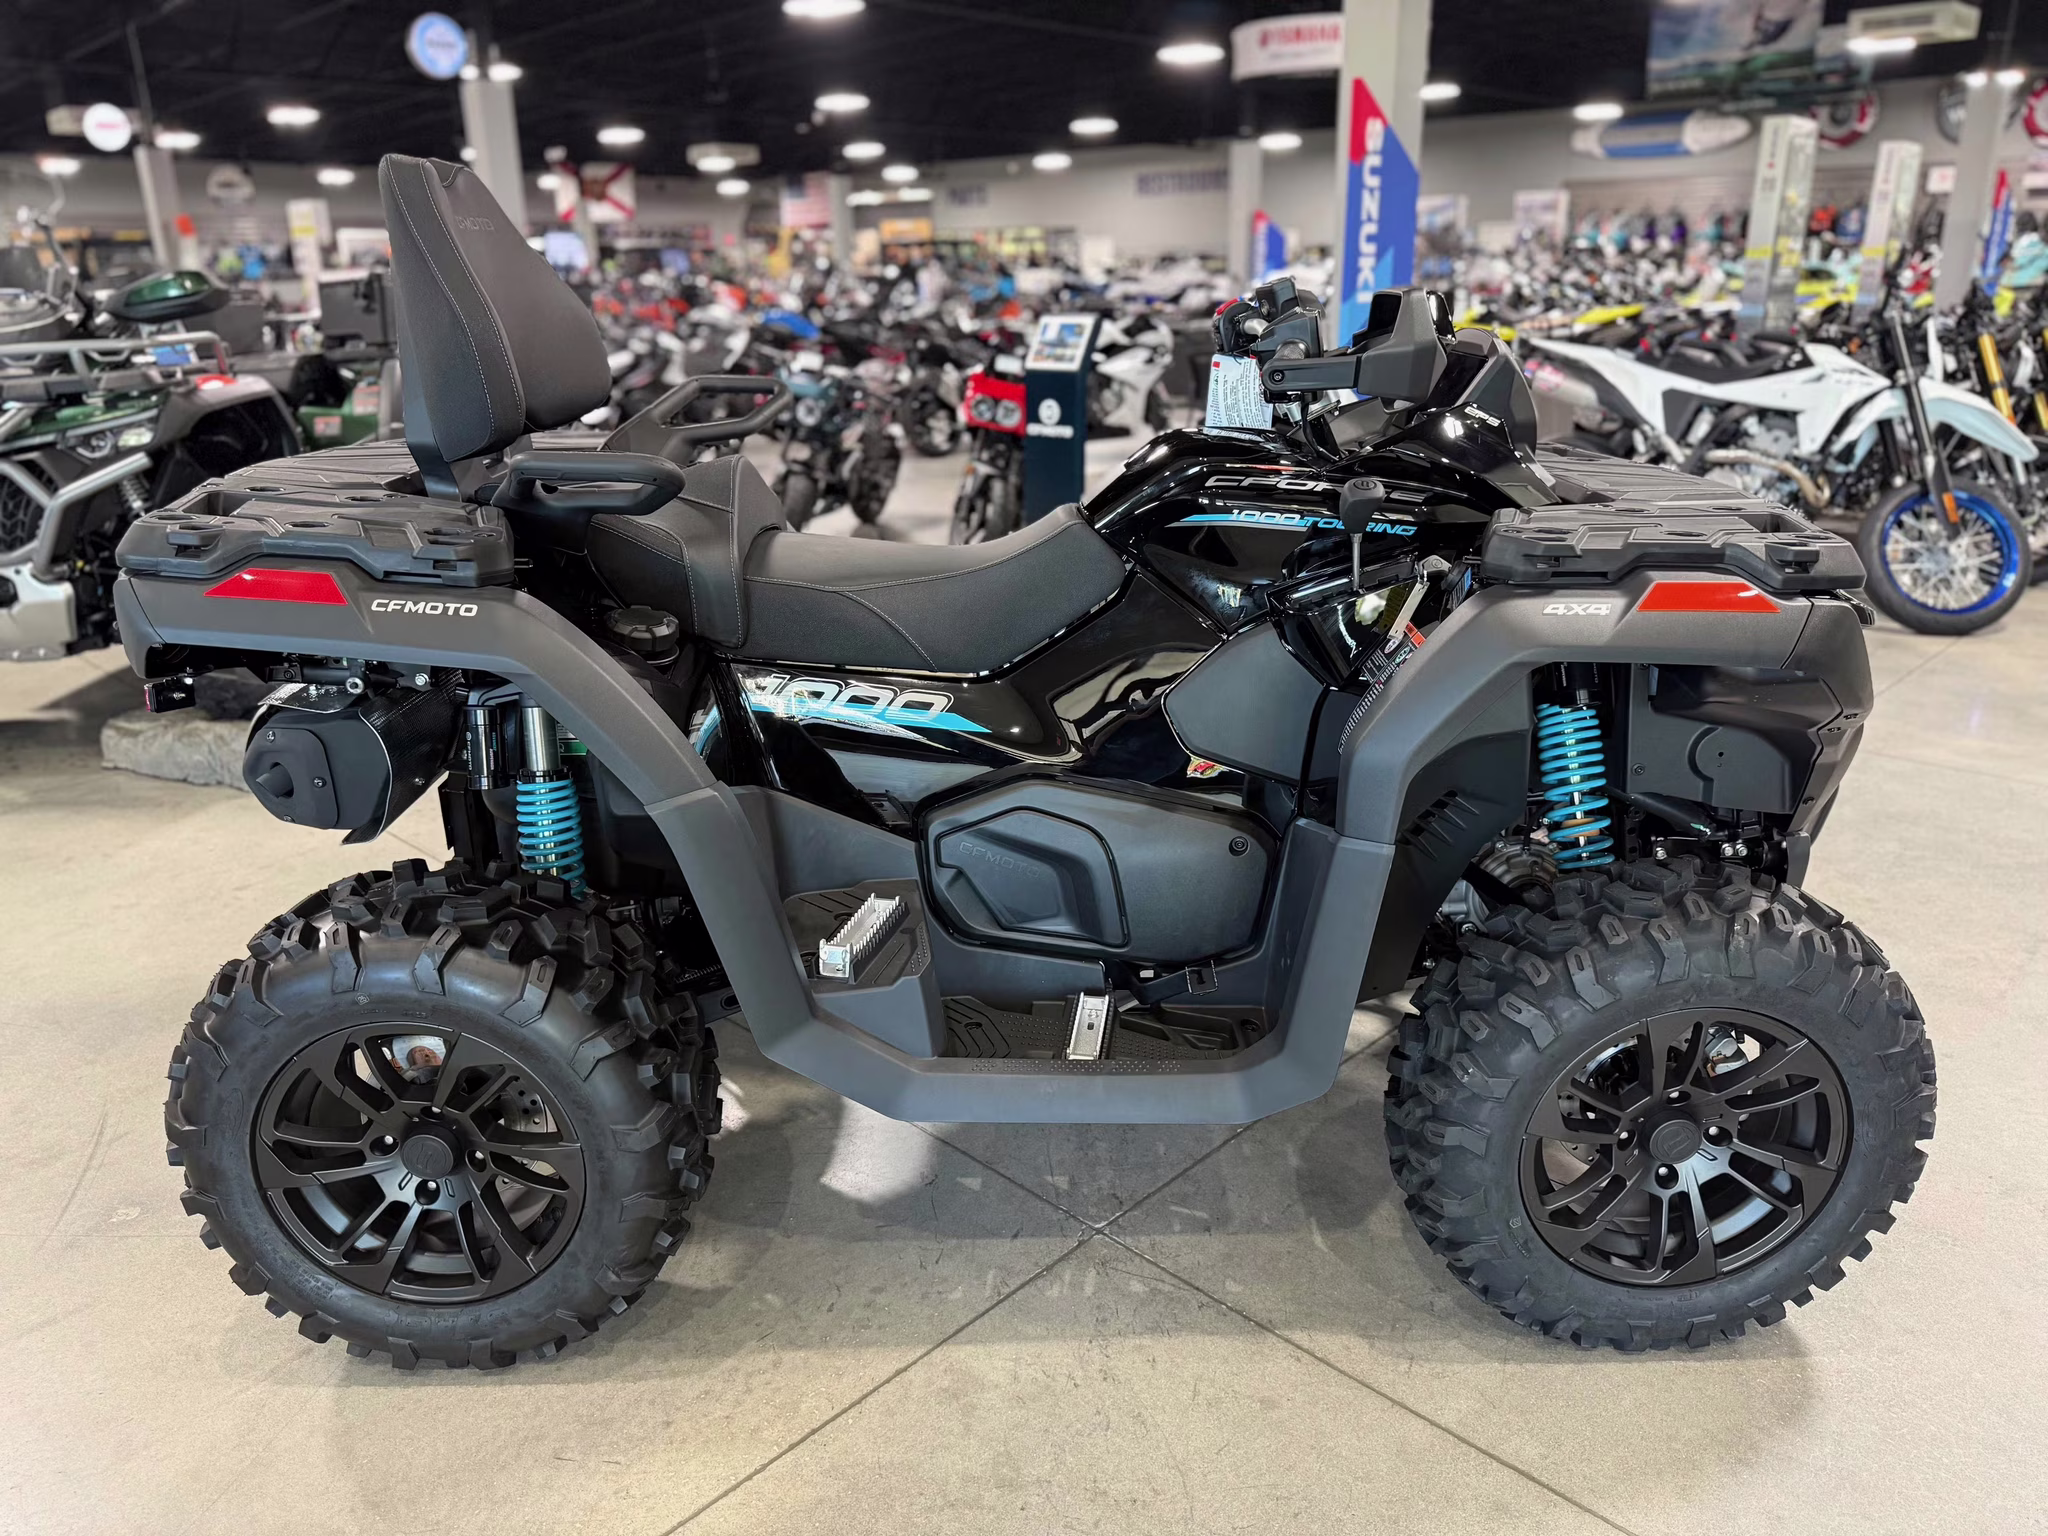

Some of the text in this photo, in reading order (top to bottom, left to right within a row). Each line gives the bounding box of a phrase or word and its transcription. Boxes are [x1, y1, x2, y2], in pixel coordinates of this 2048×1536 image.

[1356, 116, 1384, 304] SUZUKI
[1464, 406, 1501, 427] EPS
[1204, 475, 1429, 503] CFORE
[371, 599, 478, 617] CFMOTO
[960, 841, 1041, 877] CFMOTO
